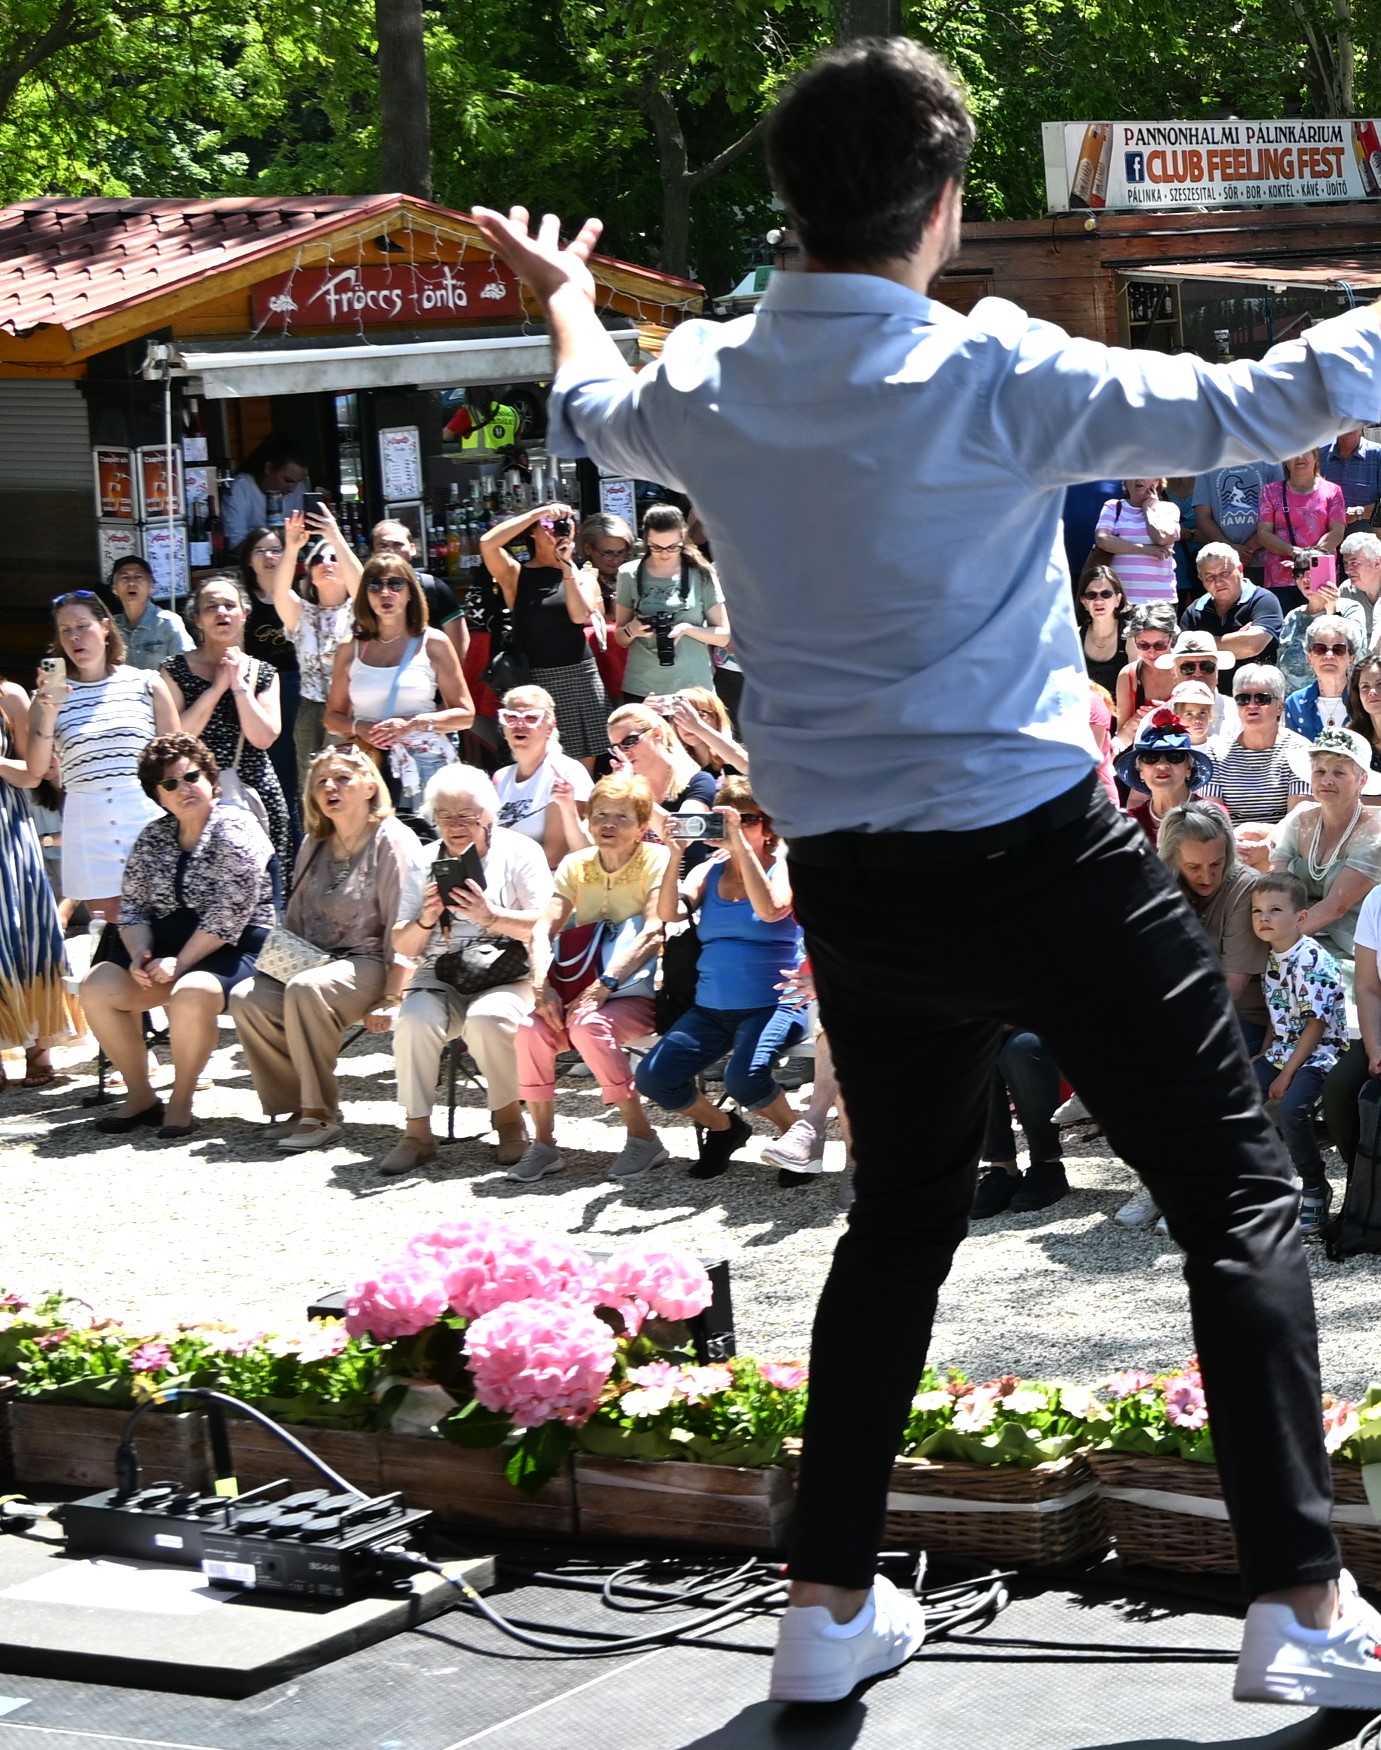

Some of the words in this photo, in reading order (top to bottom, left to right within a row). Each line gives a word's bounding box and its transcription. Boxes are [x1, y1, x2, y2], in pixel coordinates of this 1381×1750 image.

[1124, 126, 1239, 146] PANNONHALMI
[1246, 122, 1344, 144] PÁLINKÁRIUM
[1146, 149, 1204, 184] CLUB
[1207, 147, 1295, 182] FEELING
[1298, 147, 1345, 180] FEST
[1127, 186, 1162, 203] PÁLINKA
[1246, 185, 1261, 199] BOR
[1268, 181, 1295, 198] KOKTÉL
[1301, 180, 1319, 197] KÁVÉ
[306, 268, 403, 323] Fröccs
